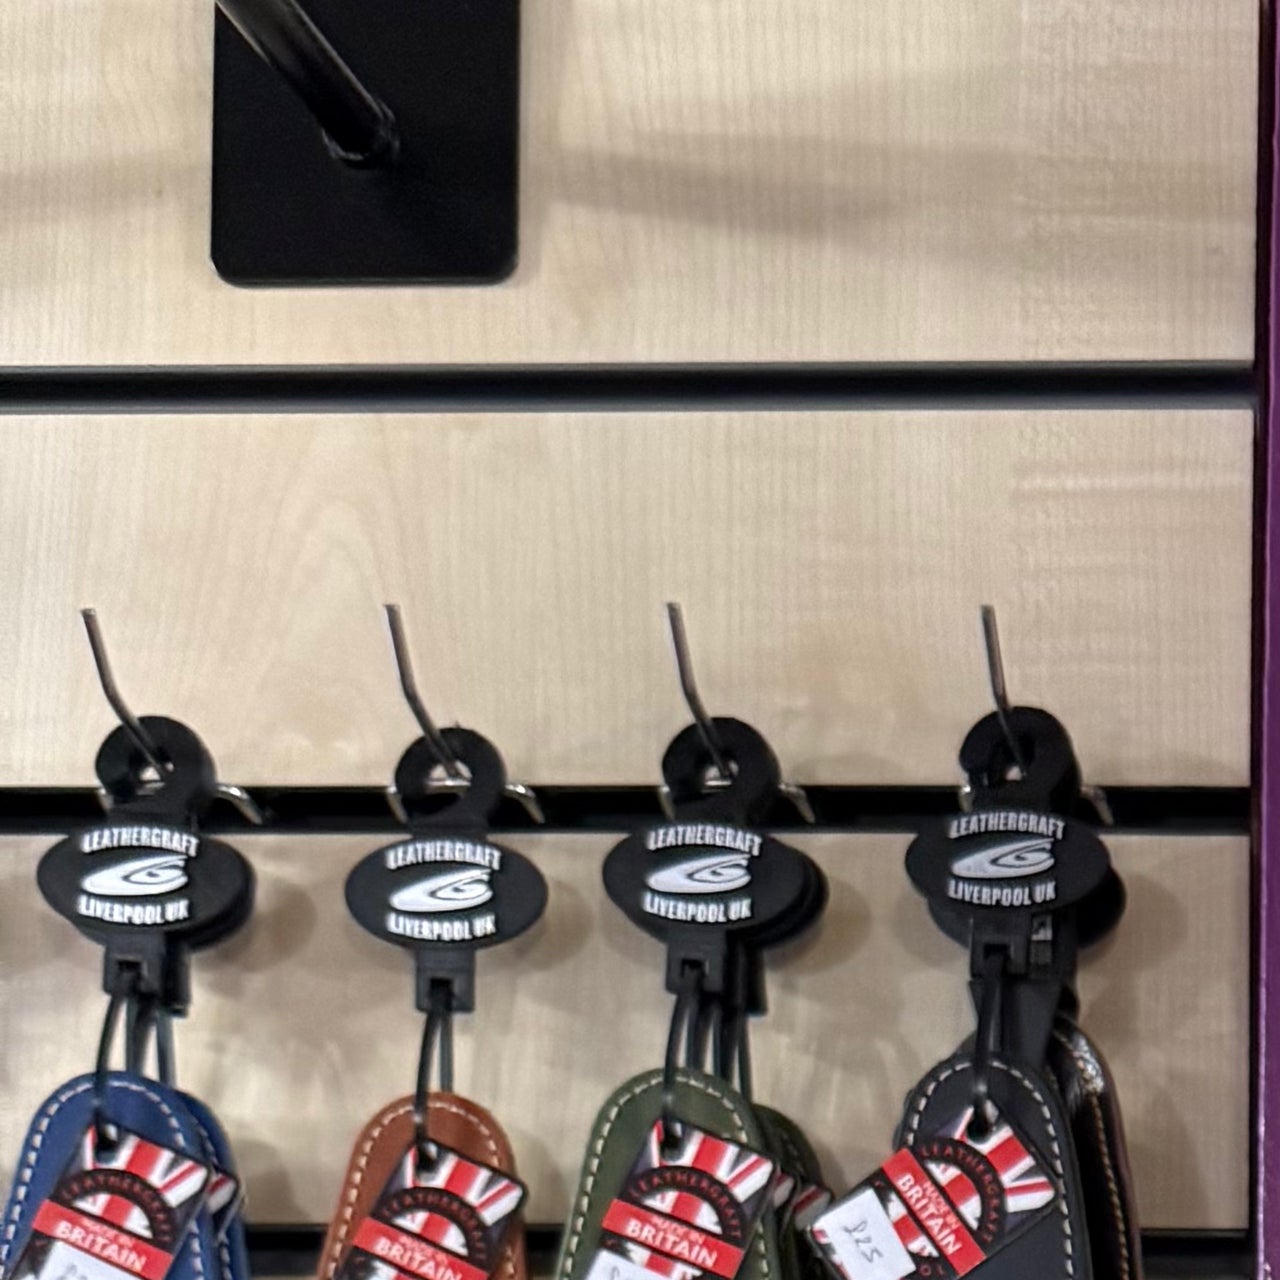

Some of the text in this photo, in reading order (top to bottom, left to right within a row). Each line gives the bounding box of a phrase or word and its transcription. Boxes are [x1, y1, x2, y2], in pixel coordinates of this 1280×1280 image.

[948, 878, 1056, 907] LIVERPOOL UK
[79, 896, 189, 925] LIVERPOOL UK
[643, 893, 752, 923] LIVERPOOL UK
[386, 913, 496, 941] LIVERPOOL UK
[899, 1174, 963, 1254] BRITAIN
[54, 1221, 148, 1273] BRITAIN
[626, 1218, 717, 1268] BRITAIN
